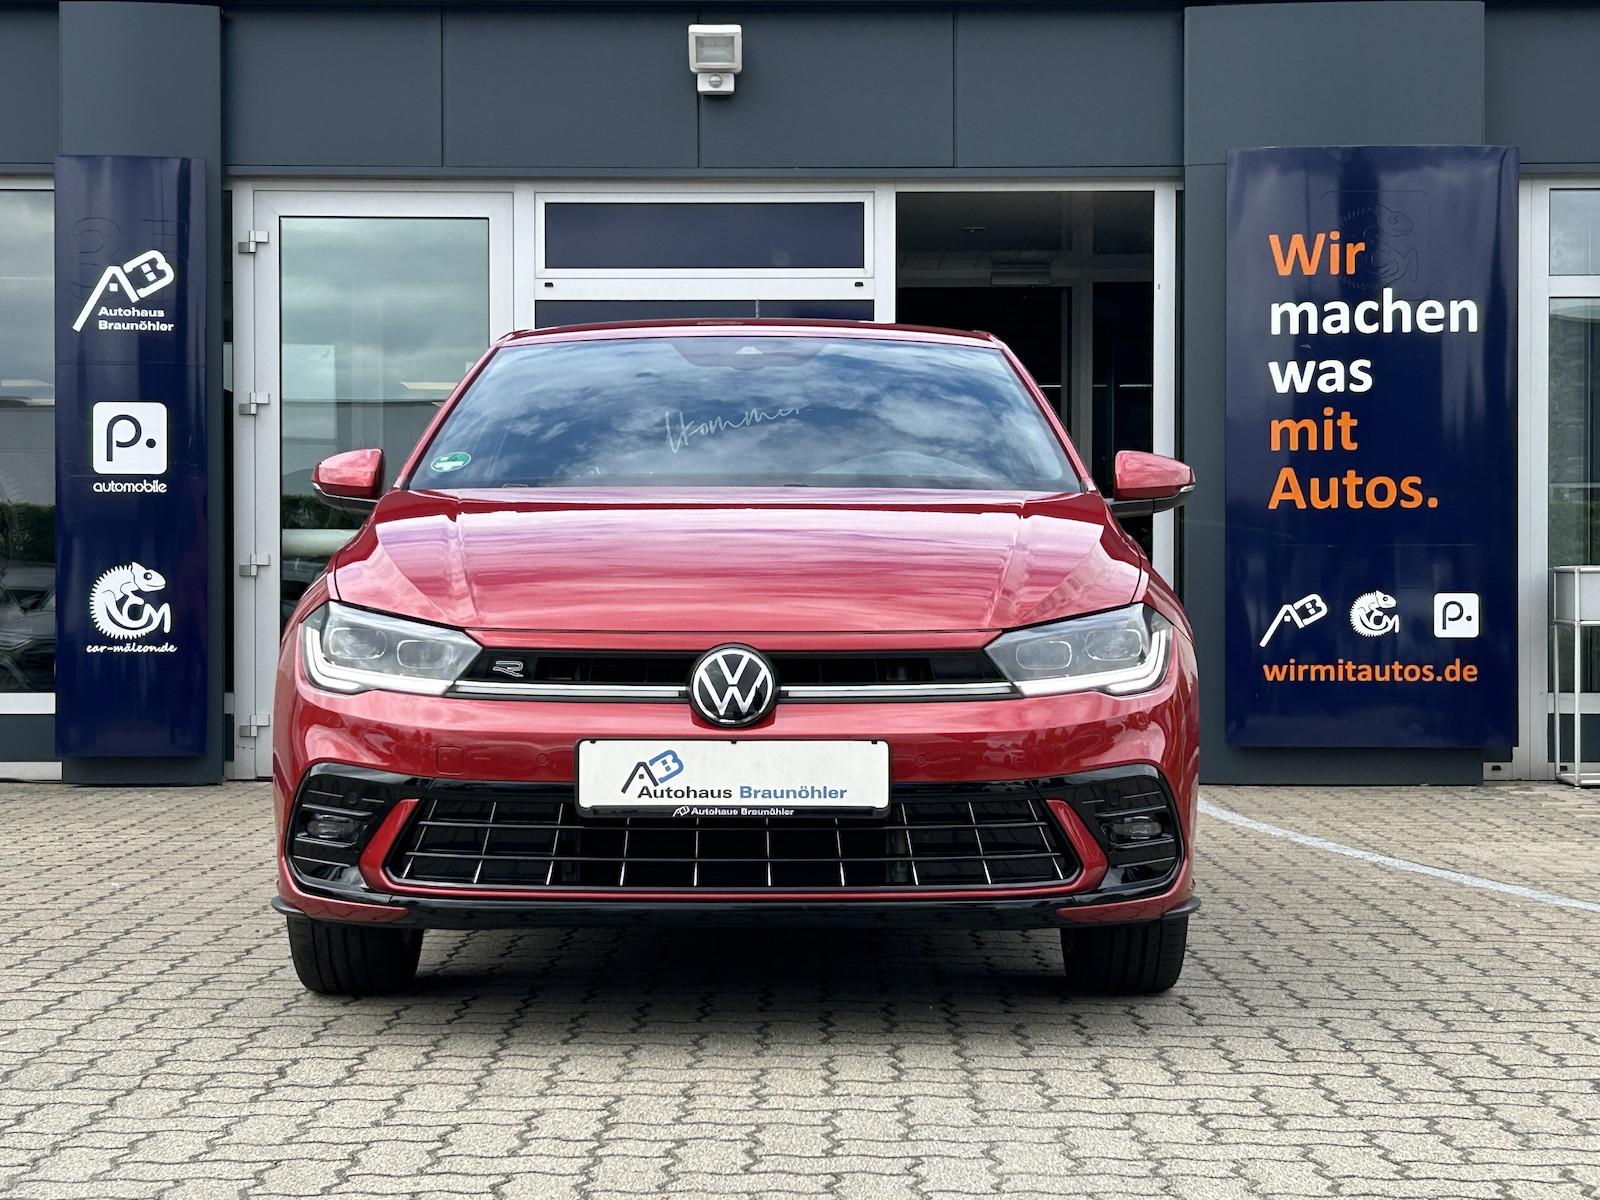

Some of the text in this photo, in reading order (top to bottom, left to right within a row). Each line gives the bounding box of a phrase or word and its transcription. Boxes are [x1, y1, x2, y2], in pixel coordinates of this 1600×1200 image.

[1268, 230, 1366, 277] Wir
[98, 306, 165, 318] Autohaus
[1270, 287, 1478, 336] machen
[98, 319, 175, 332] Braunöhler
[1268, 358, 1373, 394] was
[1270, 406, 1358, 452] mit
[92, 479, 168, 494] automobile
[1268, 466, 1439, 510] Autos.
[1263, 658, 1478, 683] wirmitautos.de
[637, 784, 848, 800] Autohaus Braunöhler
[690, 806, 795, 816] Autohaus Braunöhler
